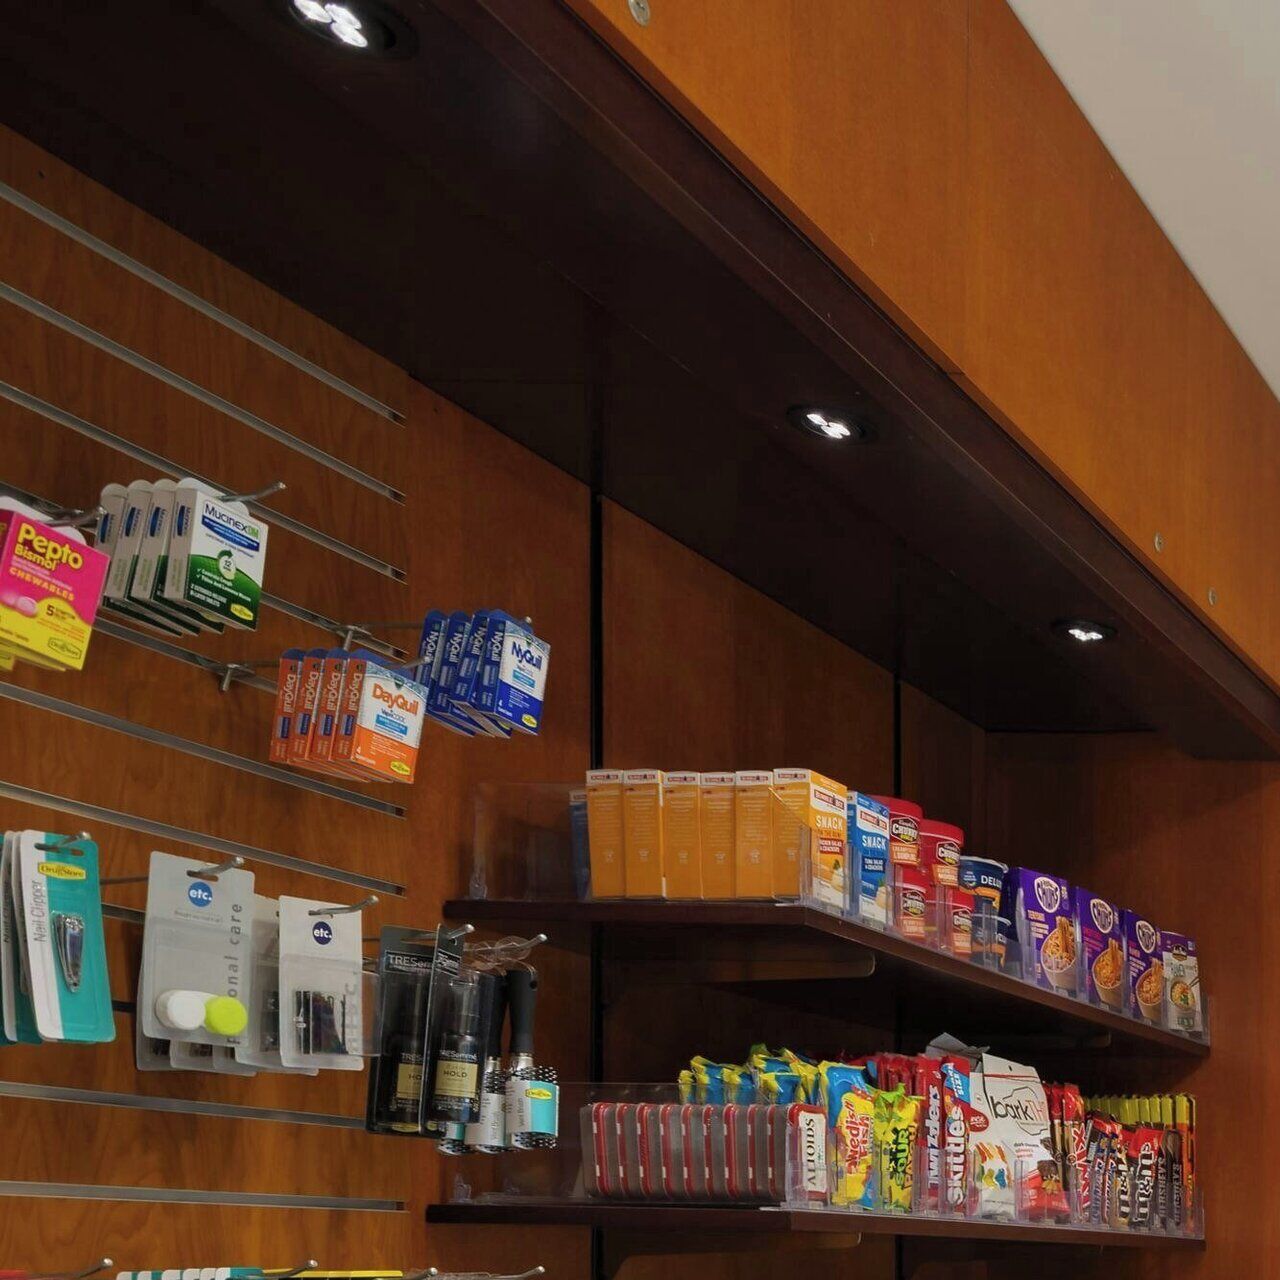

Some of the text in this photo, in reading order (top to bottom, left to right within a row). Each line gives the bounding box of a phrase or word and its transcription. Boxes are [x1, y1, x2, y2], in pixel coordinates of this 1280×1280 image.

[14, 543, 57, 572] Bismol
[18, 523, 83, 570] Pepto
[9, 567, 75, 601] CHEWABLES
[512, 641, 542, 670] NyQuil
[283, 673, 296, 713] DayQuil
[305, 671, 318, 710] DayQuil
[326, 672, 341, 711] DayQuil
[372, 683, 419, 715] DayQuil
[816, 815, 843, 830] SNACK
[862, 835, 886, 850] SNACK
[189, 888, 213, 901] etc.
[33, 916, 47, 943] Nail
[229, 903, 243, 946] care
[313, 927, 332, 939] etc.
[443, 1069, 468, 1078] HOLD
[805, 1118, 816, 1187] ALTOIDS
[894, 1127, 910, 1191] SOUR
[946, 1105, 966, 1206] Skittles
